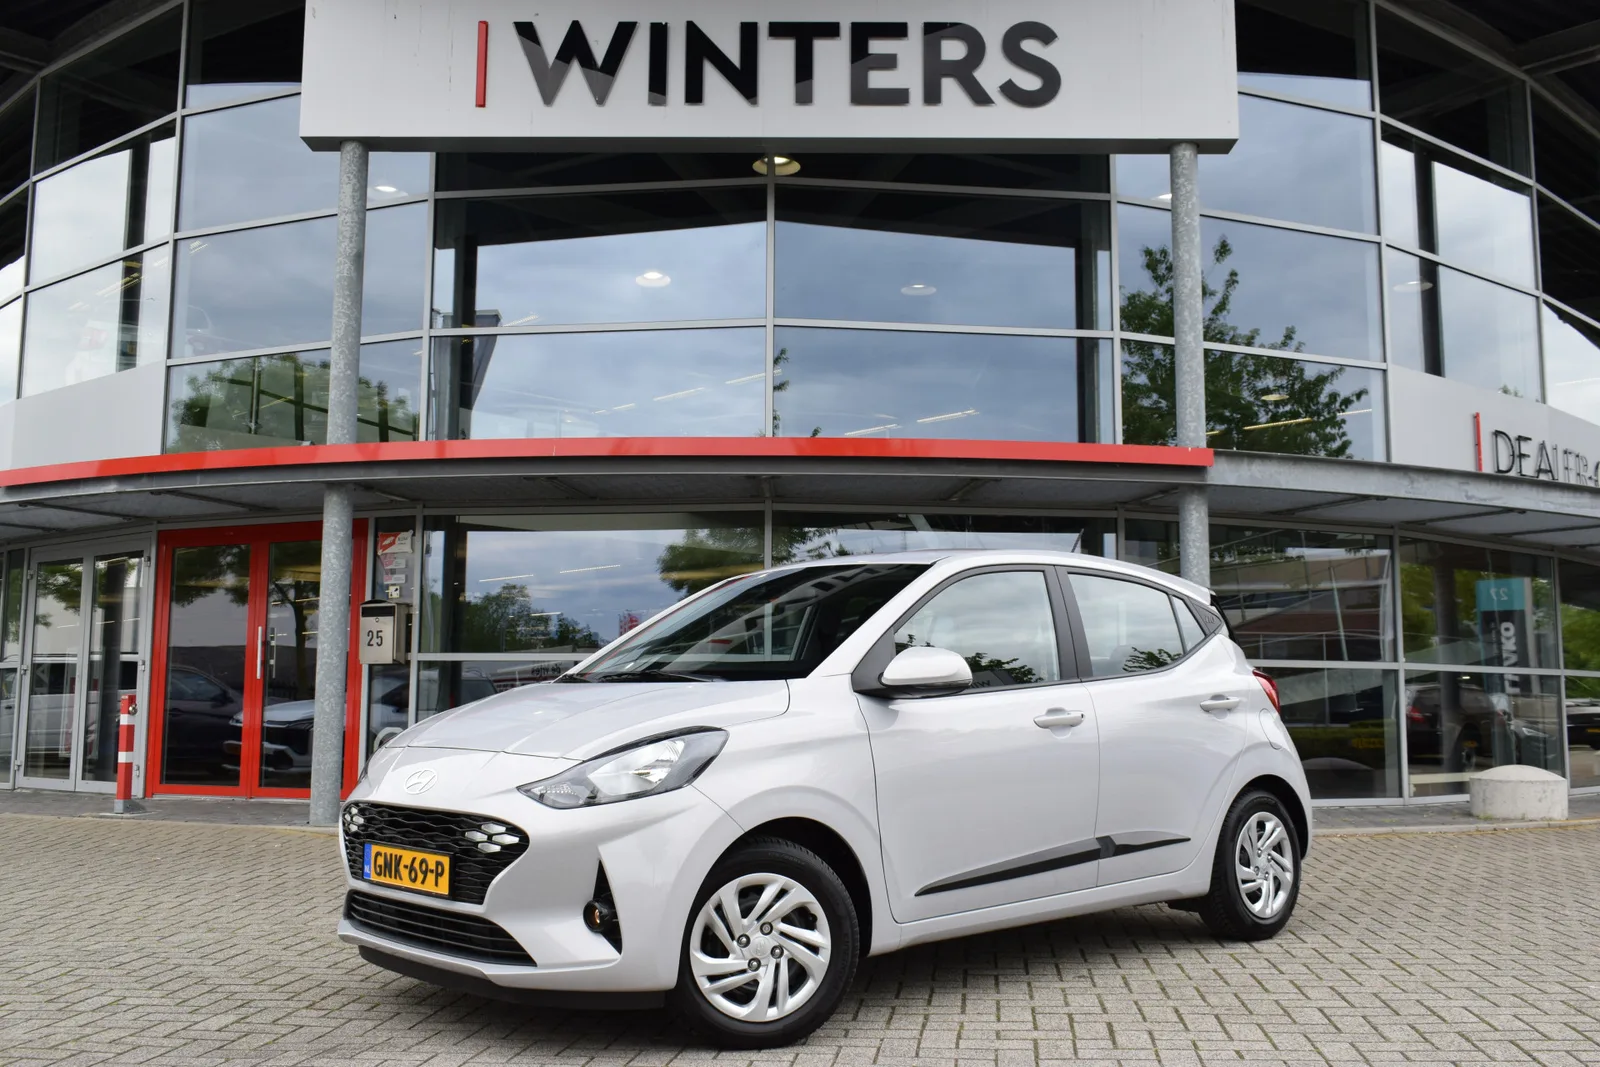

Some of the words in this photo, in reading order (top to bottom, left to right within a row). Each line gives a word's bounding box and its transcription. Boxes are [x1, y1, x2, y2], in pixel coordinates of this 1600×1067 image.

[513, 20, 1062, 107] WINTERS
[367, 629, 384, 647] 25
[373, 850, 445, 888] GNK-69-P
